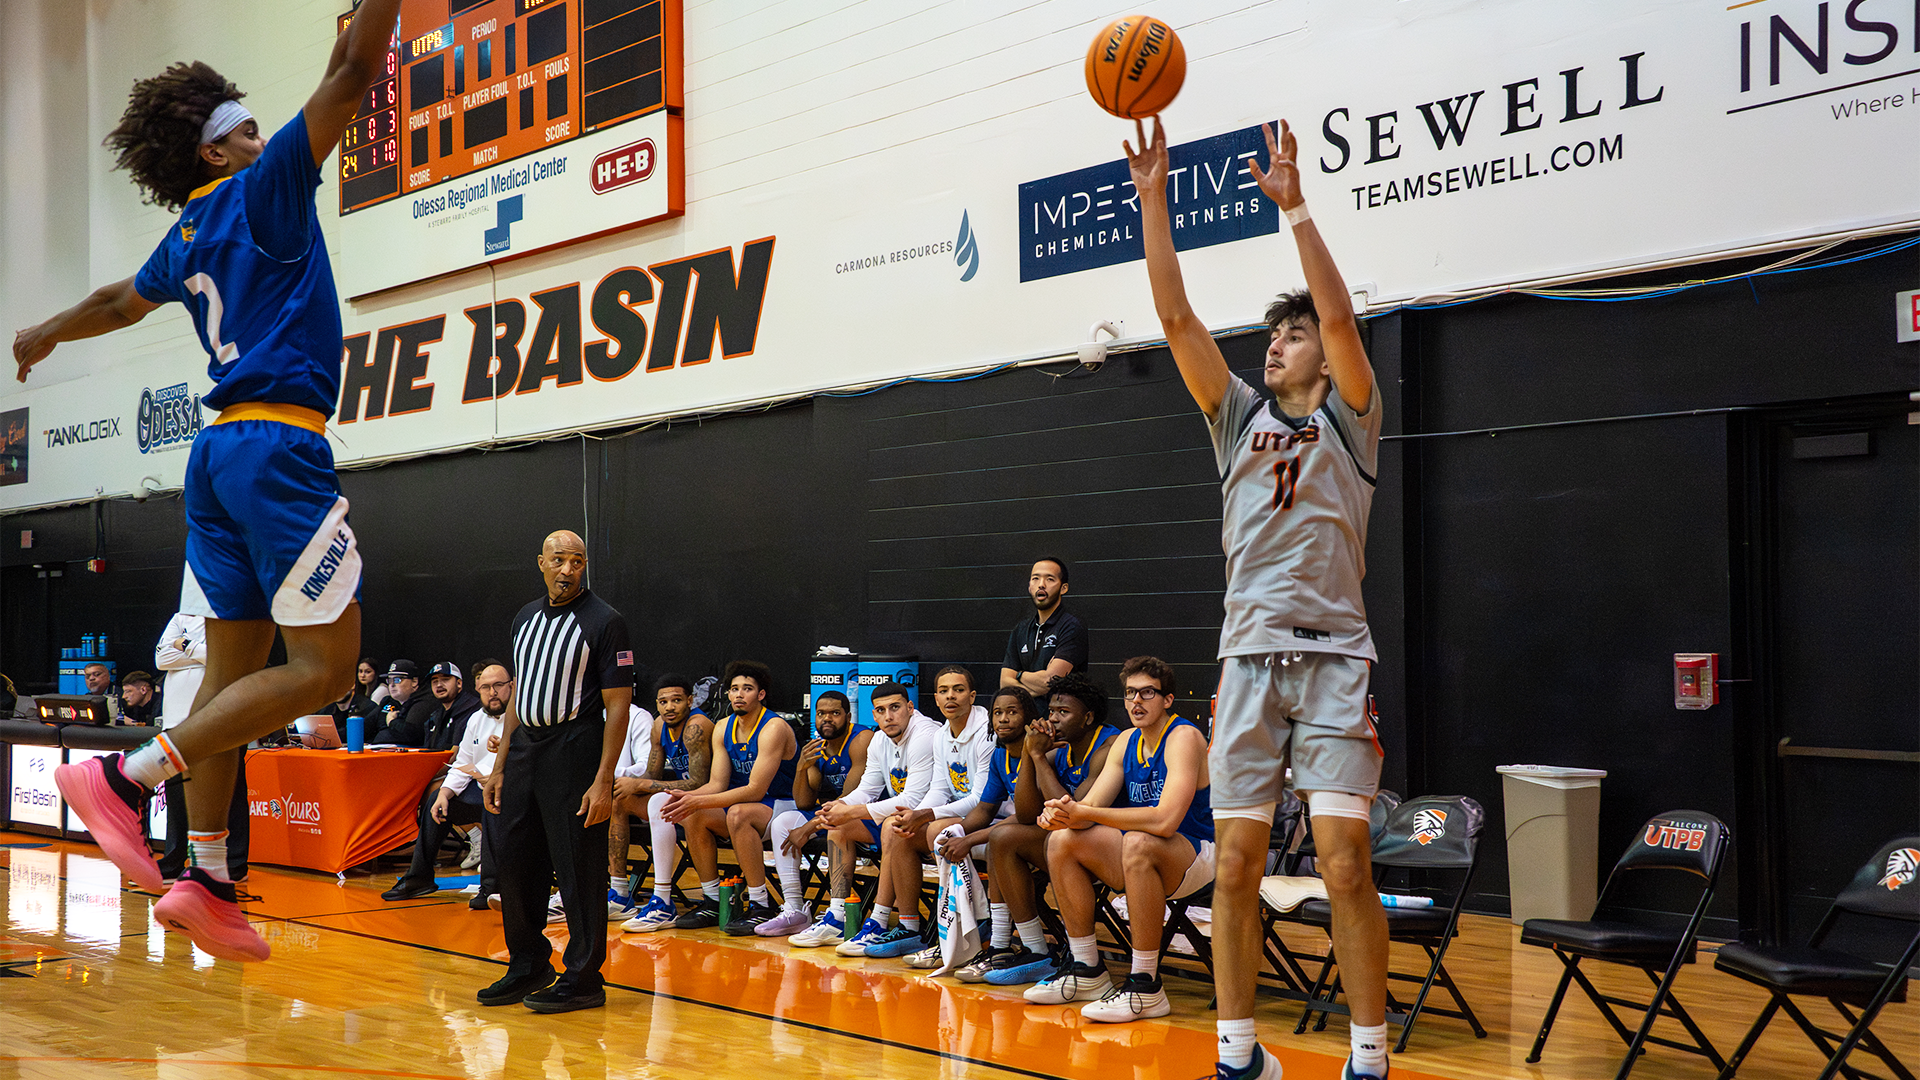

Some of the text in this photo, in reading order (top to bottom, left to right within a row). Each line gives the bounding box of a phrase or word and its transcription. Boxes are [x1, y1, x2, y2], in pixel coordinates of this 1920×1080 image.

[412, 29, 443, 57] UTPB
[471, 18, 497, 41] PERIOD
[1127, 22, 1167, 82] Wilson
[516, 71, 537, 90] T.O.L.
[544, 57, 570, 79] FOULS
[463, 80, 509, 110] PLAYER FOUL
[1831, 95, 1904, 120] Where
[409, 110, 430, 131] FOULS
[436, 102, 455, 120] T.O.L.
[1319, 51, 1664, 174] SEWELL
[545, 120, 570, 142] SCORE
[342, 155, 357, 178] 24
[473, 145, 498, 166] MATCH
[409, 168, 431, 188] SCORE
[1351, 134, 1624, 211] TEAMSEWELL.COM
[413, 157, 568, 219] Odessa Regional Medical Center
[1035, 150, 1258, 235] IMPERTIVE
[1035, 198, 1260, 259] CHEMICAL RTNERS
[486, 237, 509, 252] Steward
[836, 240, 953, 274] CARMONA RESOURCES
[183, 272, 240, 365] 2
[338, 235, 776, 425] HE BASIN
[156, 385, 188, 401] DISCOVER
[43, 417, 121, 448] TANKLOGIX
[1273, 455, 1300, 511] 11
[300, 529, 349, 602] KINGSVILLE
[14, 787, 57, 808] First Basin
[249, 792, 321, 825] AKE YOURS
[1644, 825, 1706, 852] UTPB
[1670, 821, 1708, 830] FALCONS
